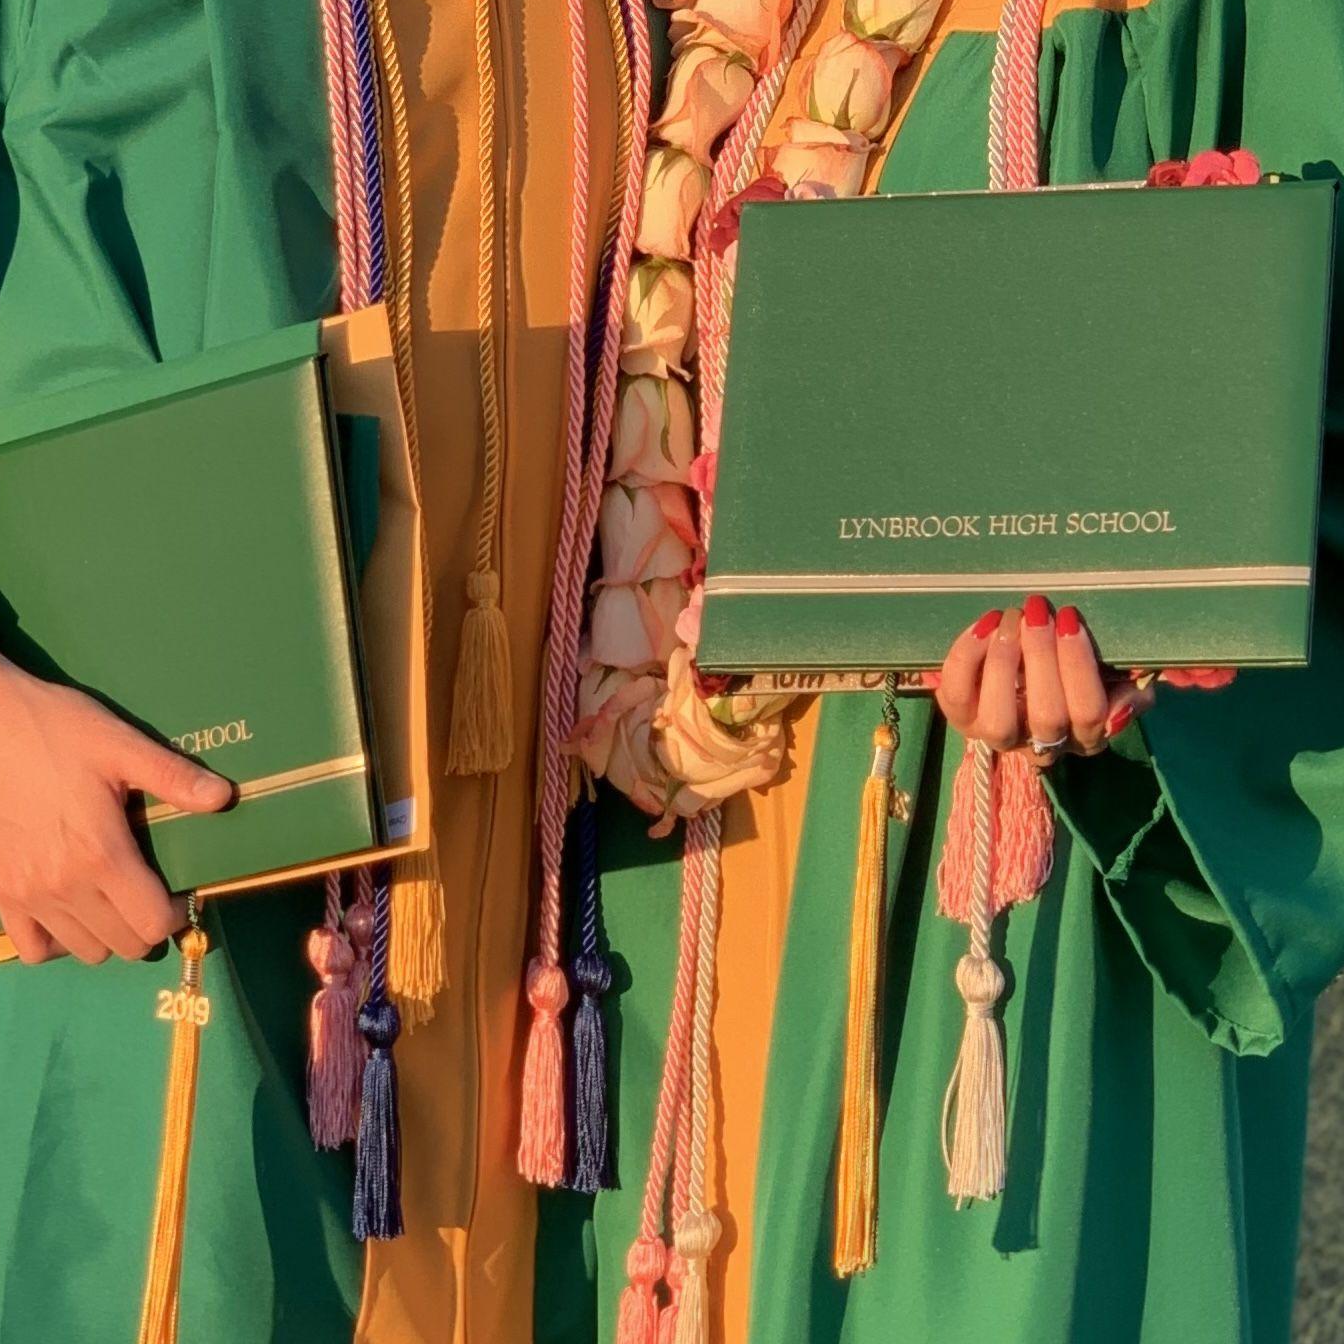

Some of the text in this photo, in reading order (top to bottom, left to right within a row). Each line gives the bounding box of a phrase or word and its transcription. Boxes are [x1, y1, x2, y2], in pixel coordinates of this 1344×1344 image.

[839, 511, 1177, 539] LYNBROOK HIGH SCHOOL
[156, 989, 210, 1026] 2019
